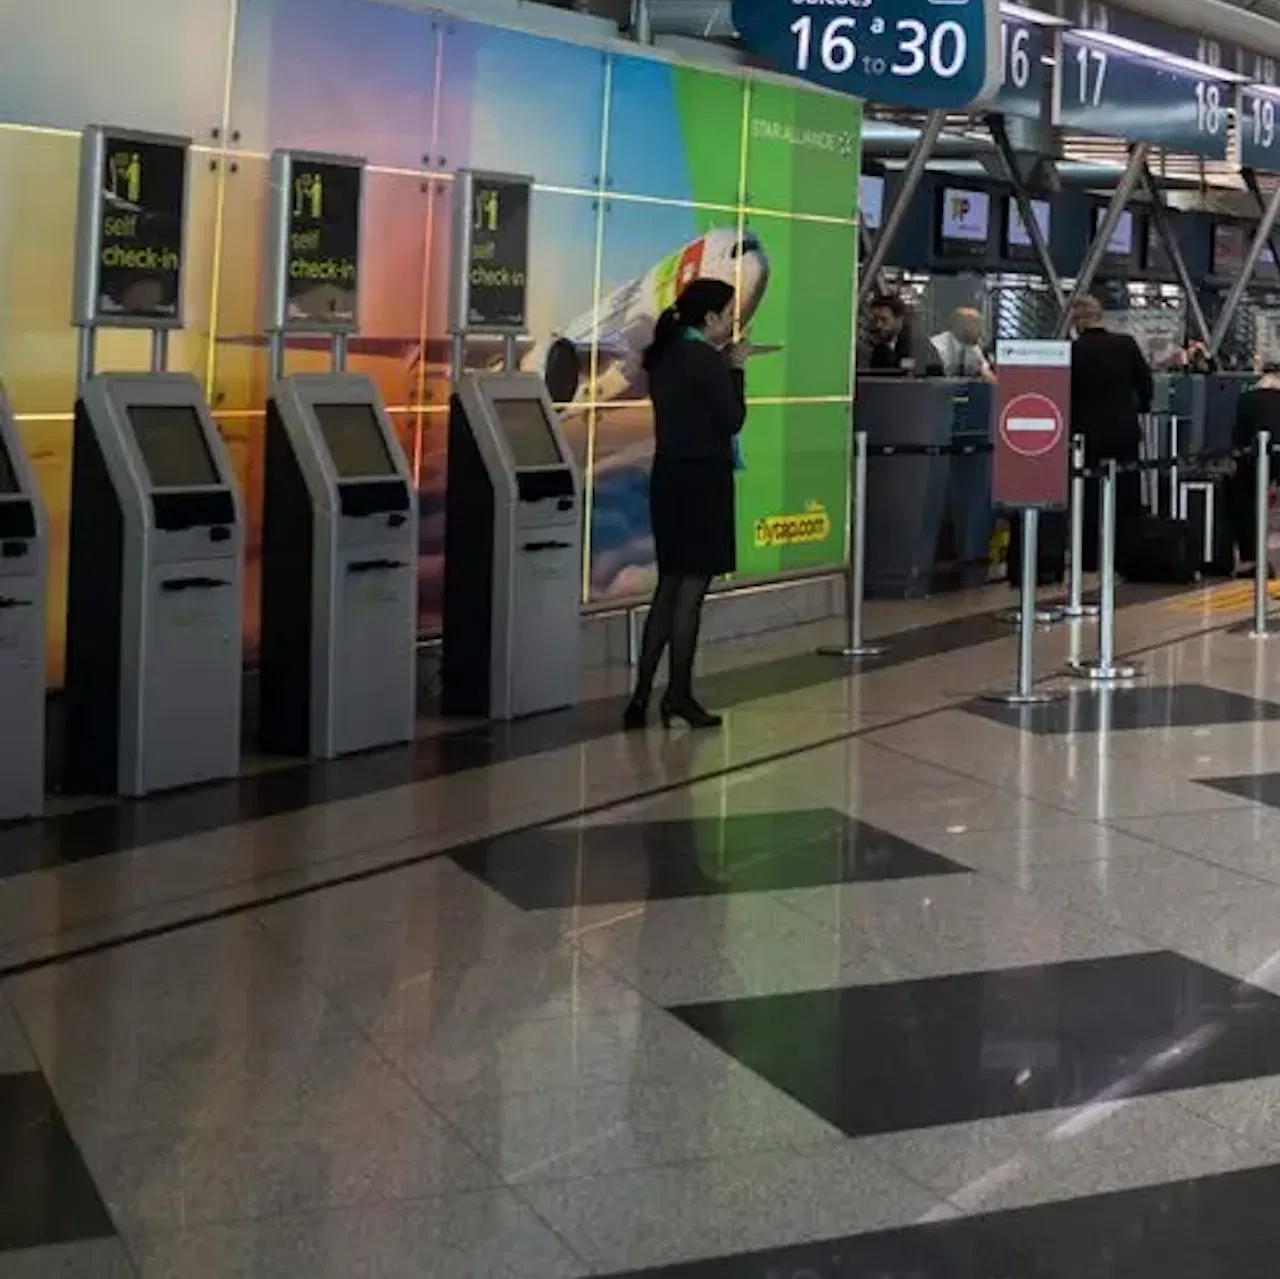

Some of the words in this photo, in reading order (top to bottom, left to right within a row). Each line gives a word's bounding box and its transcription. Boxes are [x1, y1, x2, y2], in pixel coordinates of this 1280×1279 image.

[789, 14, 857, 73] 16
[889, 17, 968, 78] 30
[1076, 45, 1108, 108] 17
[1195, 80, 1220, 135] 18
[1251, 97, 1276, 148] 19
[104, 213, 138, 237] self
[103, 244, 178, 271] check-in
[289, 258, 356, 279] check-in
[471, 265, 525, 287] check-in
